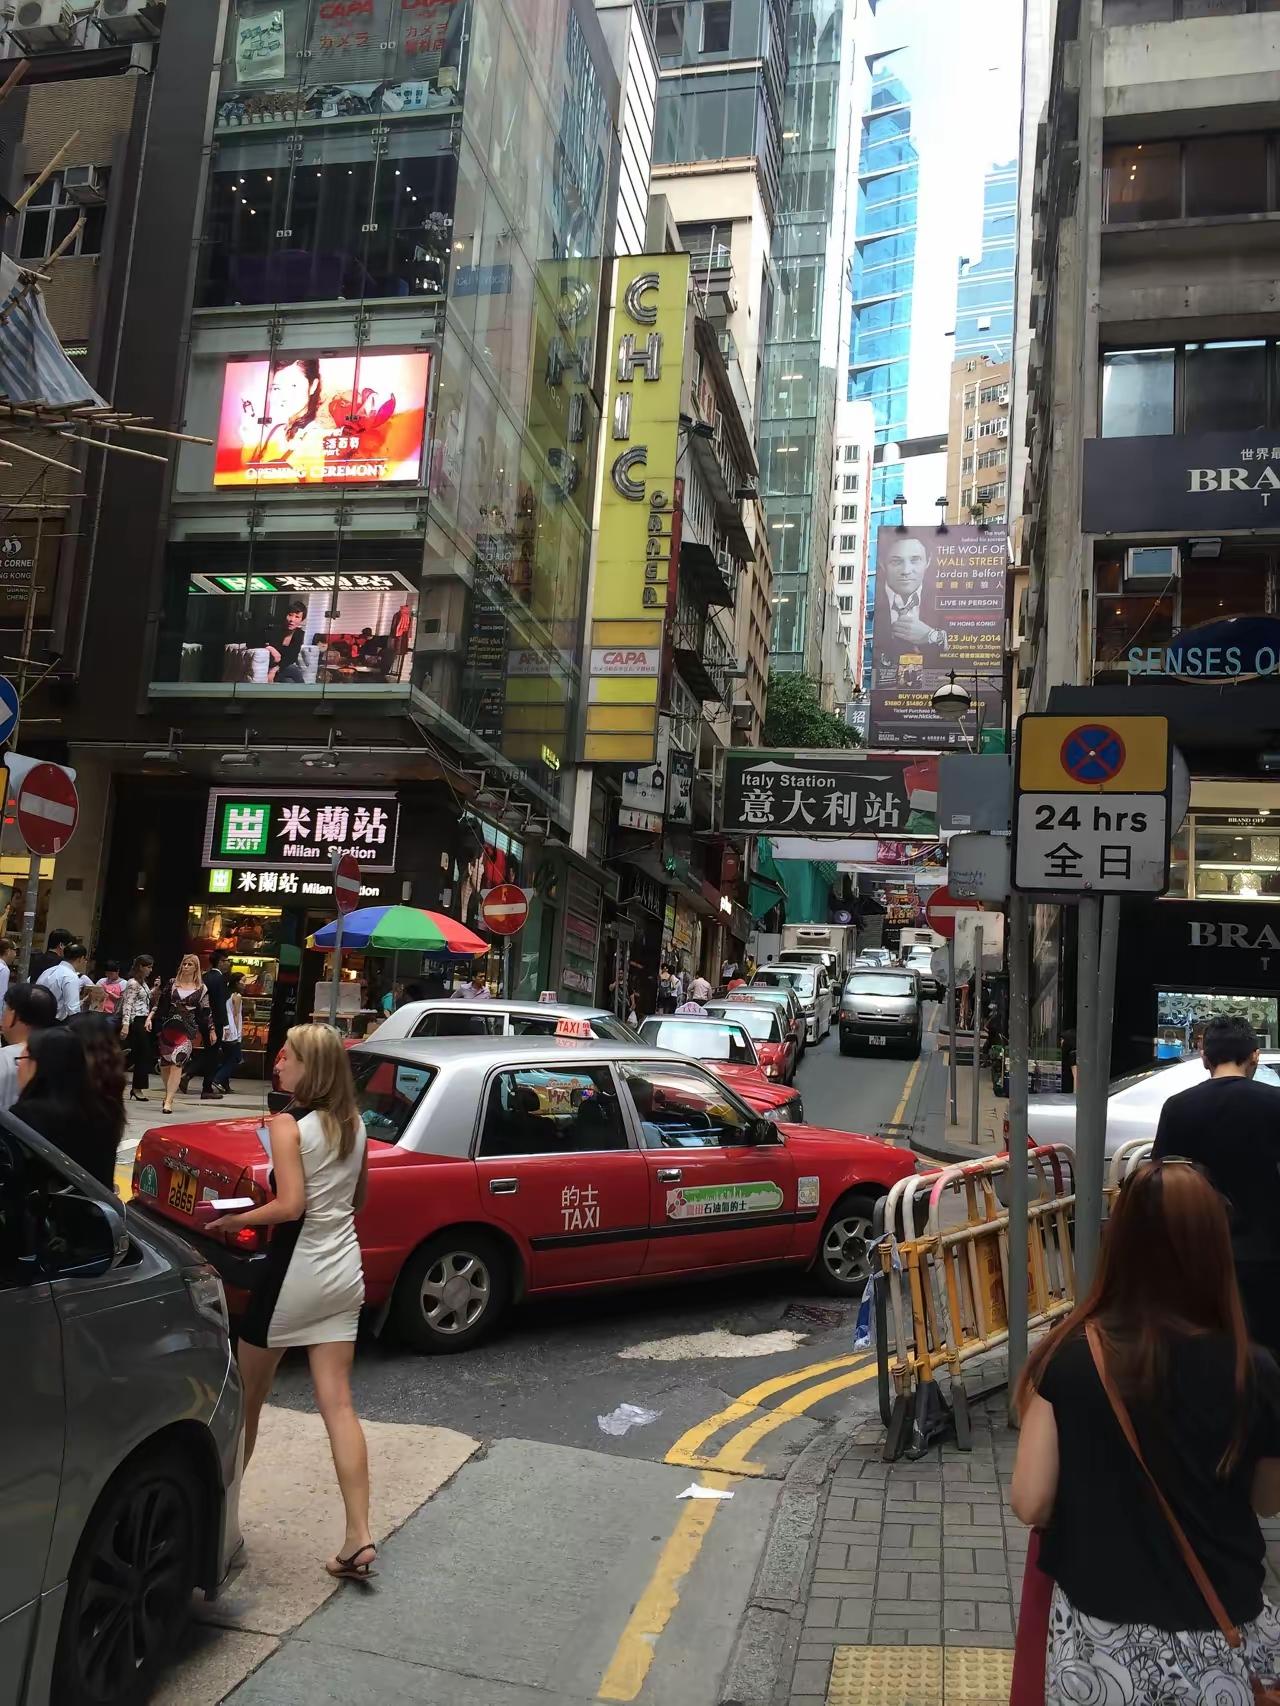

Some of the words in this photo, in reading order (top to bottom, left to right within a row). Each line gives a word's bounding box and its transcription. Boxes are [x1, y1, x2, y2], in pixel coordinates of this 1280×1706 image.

[310, 464, 389, 478] CEREMONY
[936, 545, 955, 555] THE
[958, 545, 987, 554] WOLF
[990, 545, 1005, 554] OF
[936, 557, 965, 566] WALL
[969, 556, 1005, 566] STREET
[936, 570, 968, 578] Jordan
[972, 569, 1003, 578] Belfort
[947, 634, 959, 642] 23
[960, 634, 978, 643] July
[980, 634, 1001, 642] 2014
[603, 651, 647, 665] CAPA
[1128, 647, 1242, 676] SENSES
[741, 773, 775, 789] Italy
[779, 774, 836, 788] Station
[738, 788, 901, 829] 意大利站
[276, 804, 389, 844] 米蘭站
[1035, 804, 1081, 831] 24
[1093, 806, 1148, 832] hrs
[226, 838, 262, 851] EXIT
[283, 844, 321, 858] Milan
[327, 845, 377, 859] Station
[1044, 842, 1132, 880] 全日
[237, 871, 300, 893] 米蘭站
[302, 882, 333, 895] Milan
[558, 1021, 580, 1034] TAXI
[561, 1184, 599, 1207] 的士
[561, 1207, 600, 1231] TAXI
